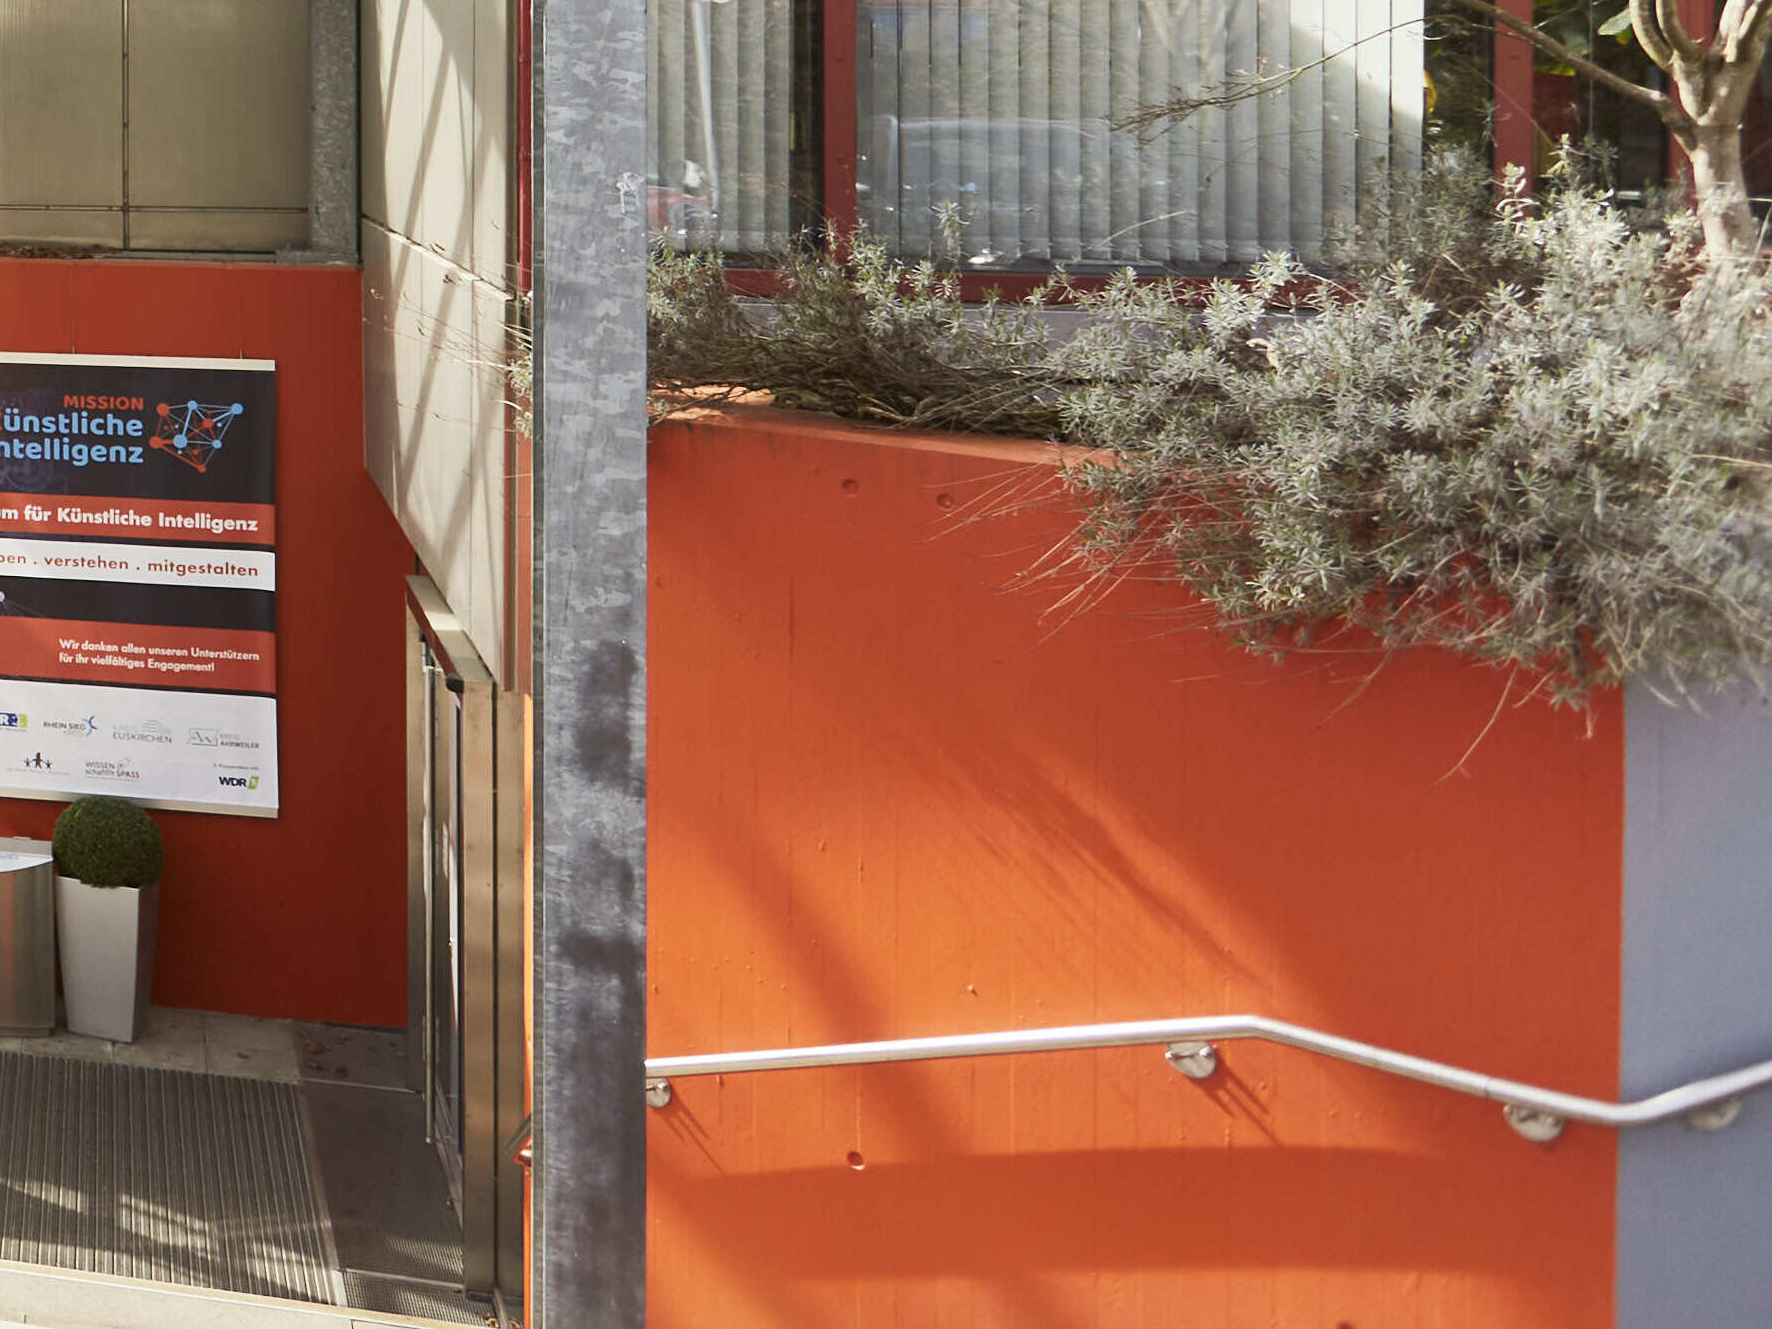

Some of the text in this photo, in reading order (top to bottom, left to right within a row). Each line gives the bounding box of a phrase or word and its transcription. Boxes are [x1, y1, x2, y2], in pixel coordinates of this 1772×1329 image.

[63, 395, 144, 410] MISSION
[24, 505, 51, 522] für
[57, 507, 153, 527] Künstliche
[159, 513, 258, 533] Intelligenz
[44, 555, 129, 570] verstehen
[148, 561, 259, 577] mitgestalten
[59, 638, 260, 661] Wir danken allen unseren Unterstützern
[59, 653, 73, 663] für
[91, 655, 145, 669] vielfältiges
[148, 658, 215, 673] Engagement!
[219, 776, 247, 787] WDR
